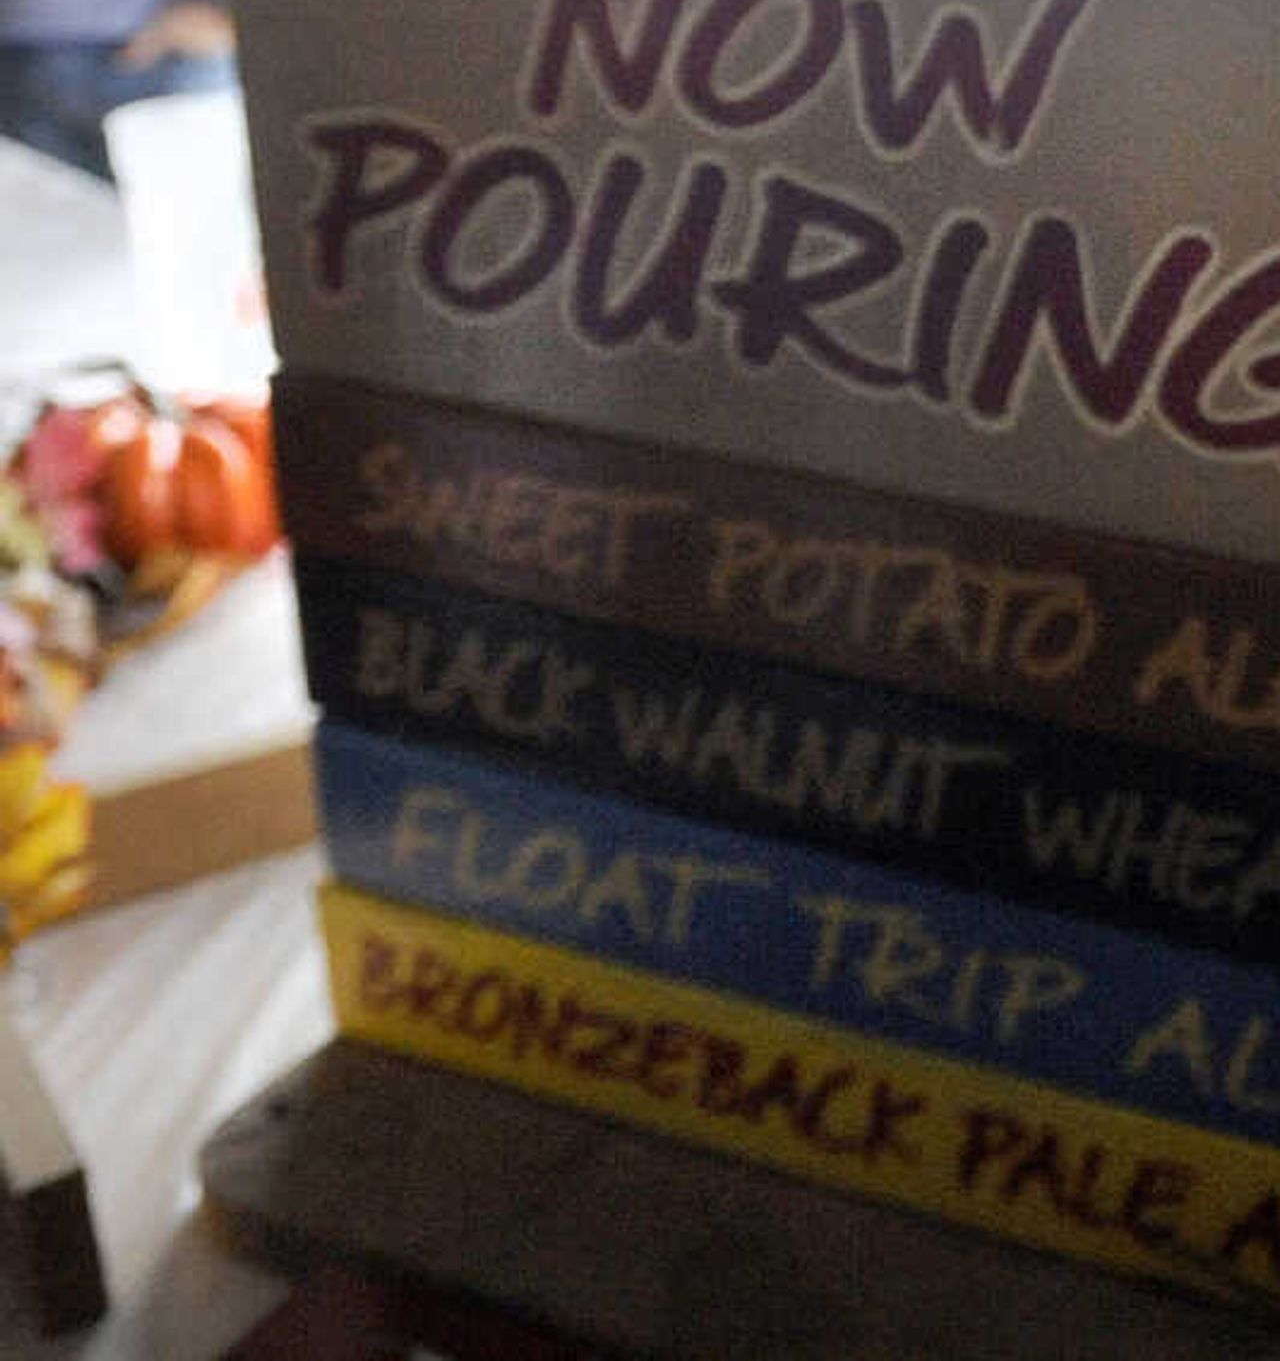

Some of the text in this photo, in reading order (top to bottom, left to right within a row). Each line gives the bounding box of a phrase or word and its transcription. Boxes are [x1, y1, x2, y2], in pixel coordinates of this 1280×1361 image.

[355, 442, 692, 585] SWEET
[706, 515, 1098, 681] POTATO
[357, 605, 596, 735] BLACK
[612, 689, 1012, 839] WALNUT
[390, 787, 772, 945] FLOAT
[796, 889, 1086, 1037] TRIP
[357, 935, 928, 1167] BRONZEBACK
[954, 1101, 1198, 1245] PALE
